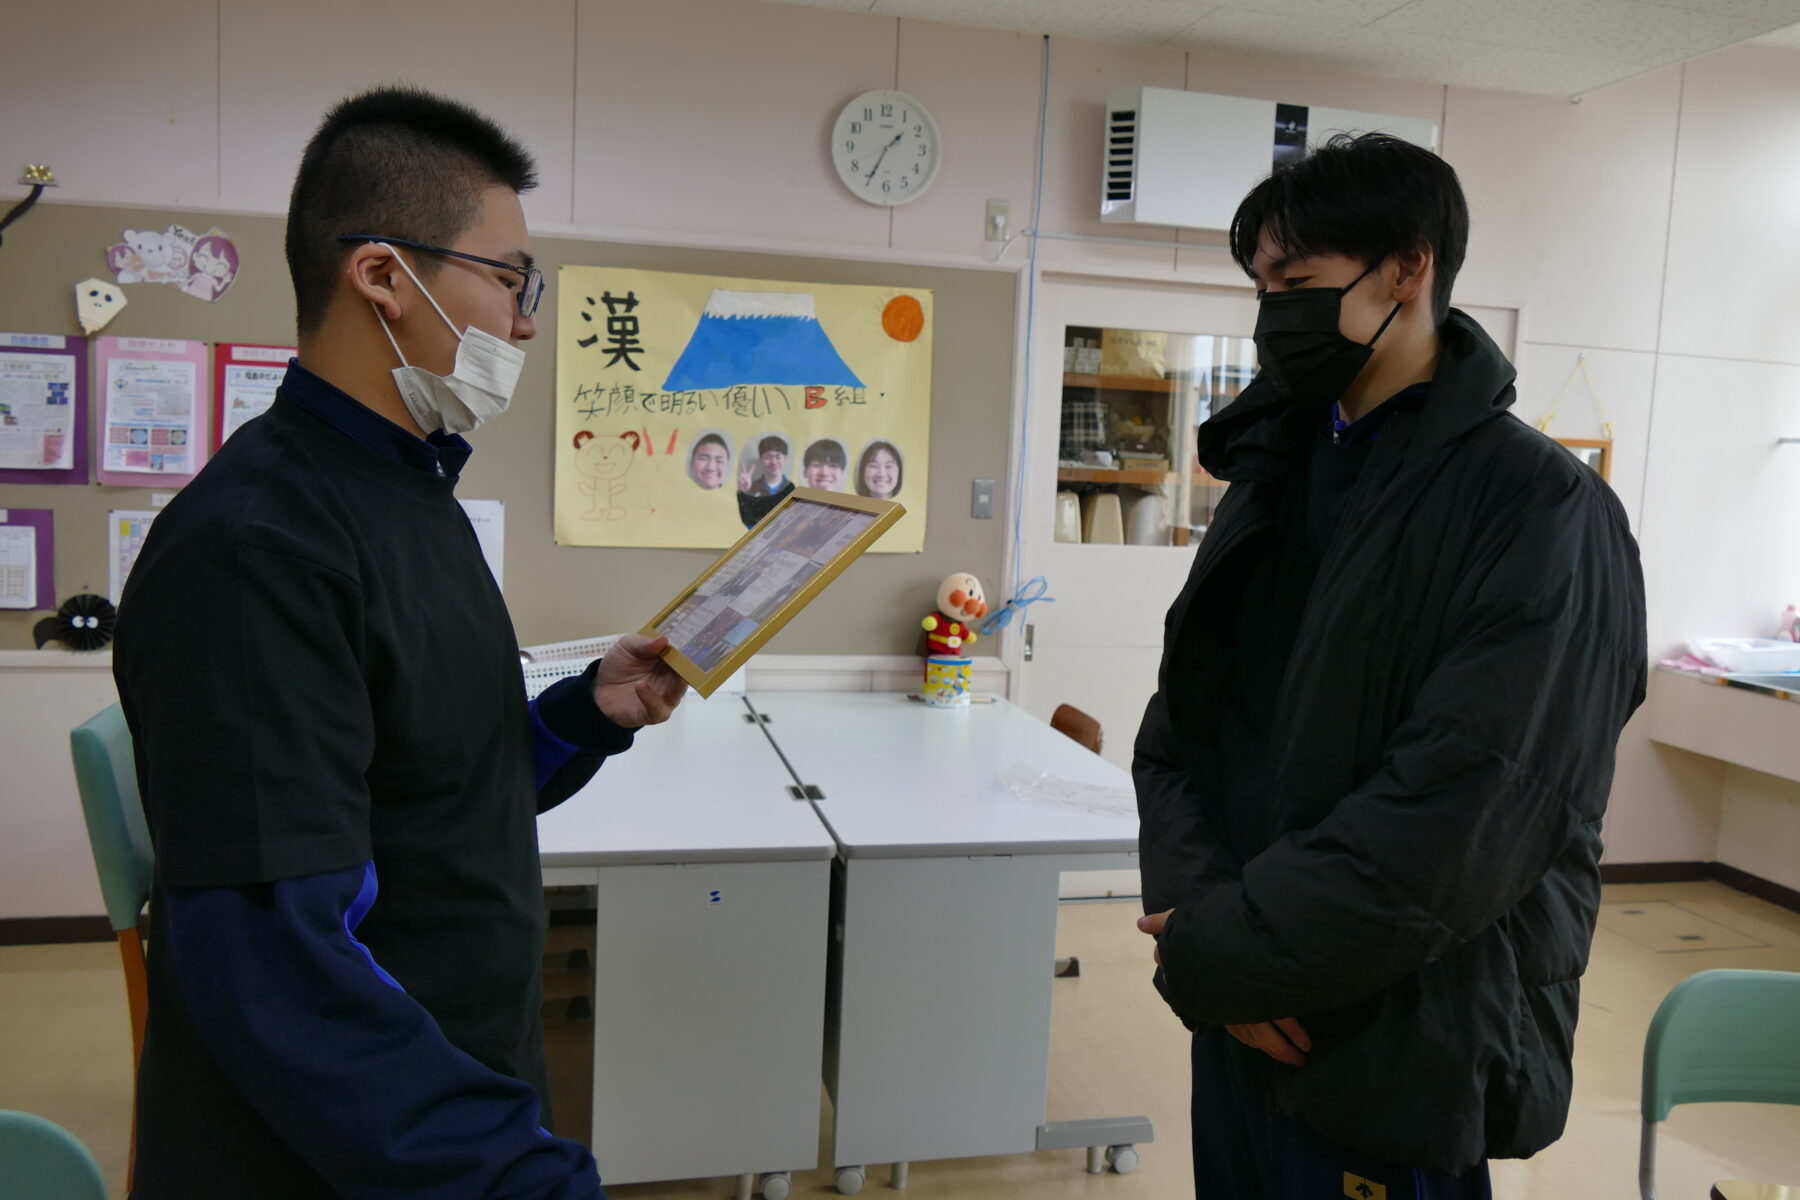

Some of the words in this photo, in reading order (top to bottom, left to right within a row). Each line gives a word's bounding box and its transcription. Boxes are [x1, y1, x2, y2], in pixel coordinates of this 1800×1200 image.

[864, 108, 873, 121] 11
[880, 104, 893, 117] 12
[902, 110, 907, 123] 1
[850, 121, 862, 134] 10
[913, 125, 922, 138] 2
[845, 140, 855, 153] 9
[918, 144, 927, 157] 3
[850, 160, 859, 172] 8
[912, 162, 919, 175] 4
[881, 180, 891, 193] 6
[900, 176, 909, 189] 5
[577, 290, 645, 371] 漢
